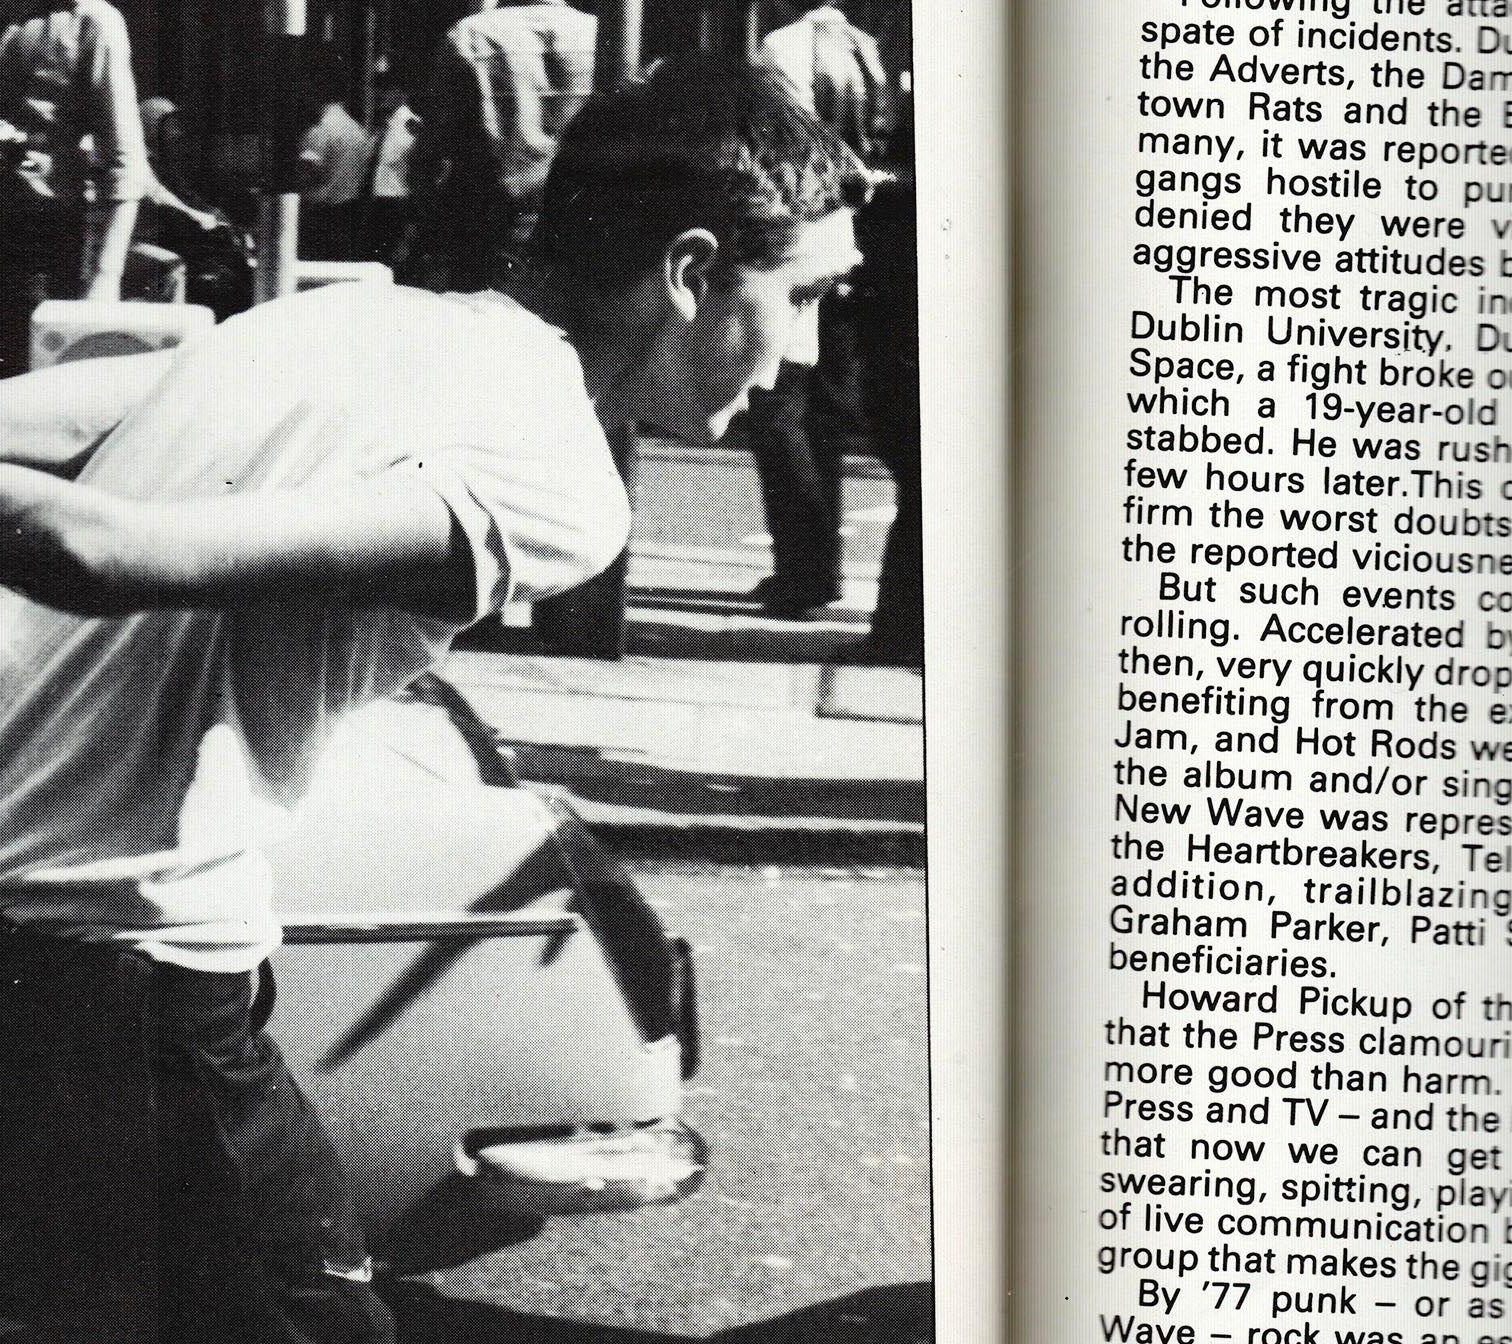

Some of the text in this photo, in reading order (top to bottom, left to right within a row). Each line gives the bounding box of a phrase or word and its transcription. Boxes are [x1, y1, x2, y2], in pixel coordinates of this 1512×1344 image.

[1141, 19, 1461, 54] spate incidents.
[1208, 53, 1355, 91] Adverts,
[1136, 90, 1323, 123] town Rats
[1138, 132, 1245, 163] many,
[1135, 166, 1382, 200] gangs hostile
[1134, 198, 1356, 242] denied they
[1132, 240, 1485, 278] aggressive attitudes
[1254, 284, 1458, 320] most tragic
[1131, 310, 1243, 344] Dublin
[1129, 347, 1474, 391] Space, fight broke
[1126, 385, 1230, 417] which
[1126, 423, 1274, 455] stabbed.
[1206, 461, 1305, 494] hours
[1122, 494, 1379, 534] firm worst
[1190, 540, 1338, 573] reported
[1239, 576, 1456, 611] such events
[1120, 608, 1465, 649] rolling. Accelerated
[1117, 645, 1425, 692] then, very quickly
[1117, 681, 1394, 725] benefiting from
[1114, 719, 1457, 761] Jam, Rods
[1183, 759, 1429, 796] album and/or
[1206, 796, 1305, 830] Wave
[1187, 833, 1440, 875] Heartbreakers,
[1111, 868, 1276, 907] addition,
[1109, 903, 1486, 948] Graham Parker, Patti
[1109, 941, 1336, 979] beneficiaries.
[1142, 979, 1412, 1025] Howard Pickup
[1104, 1015, 1345, 1054] that Press
[1104, 1060, 1387, 1094] more good than
[1103, 1090, 1194, 1123] Press
[1100, 1127, 1166, 1159] that
[1100, 1168, 1421, 1212] swearing, spitting,
[1144, 1203, 1489, 1244] live communication
[1097, 1243, 1397, 1279] group that makes
[1271, 1285, 1357, 1319] punk
